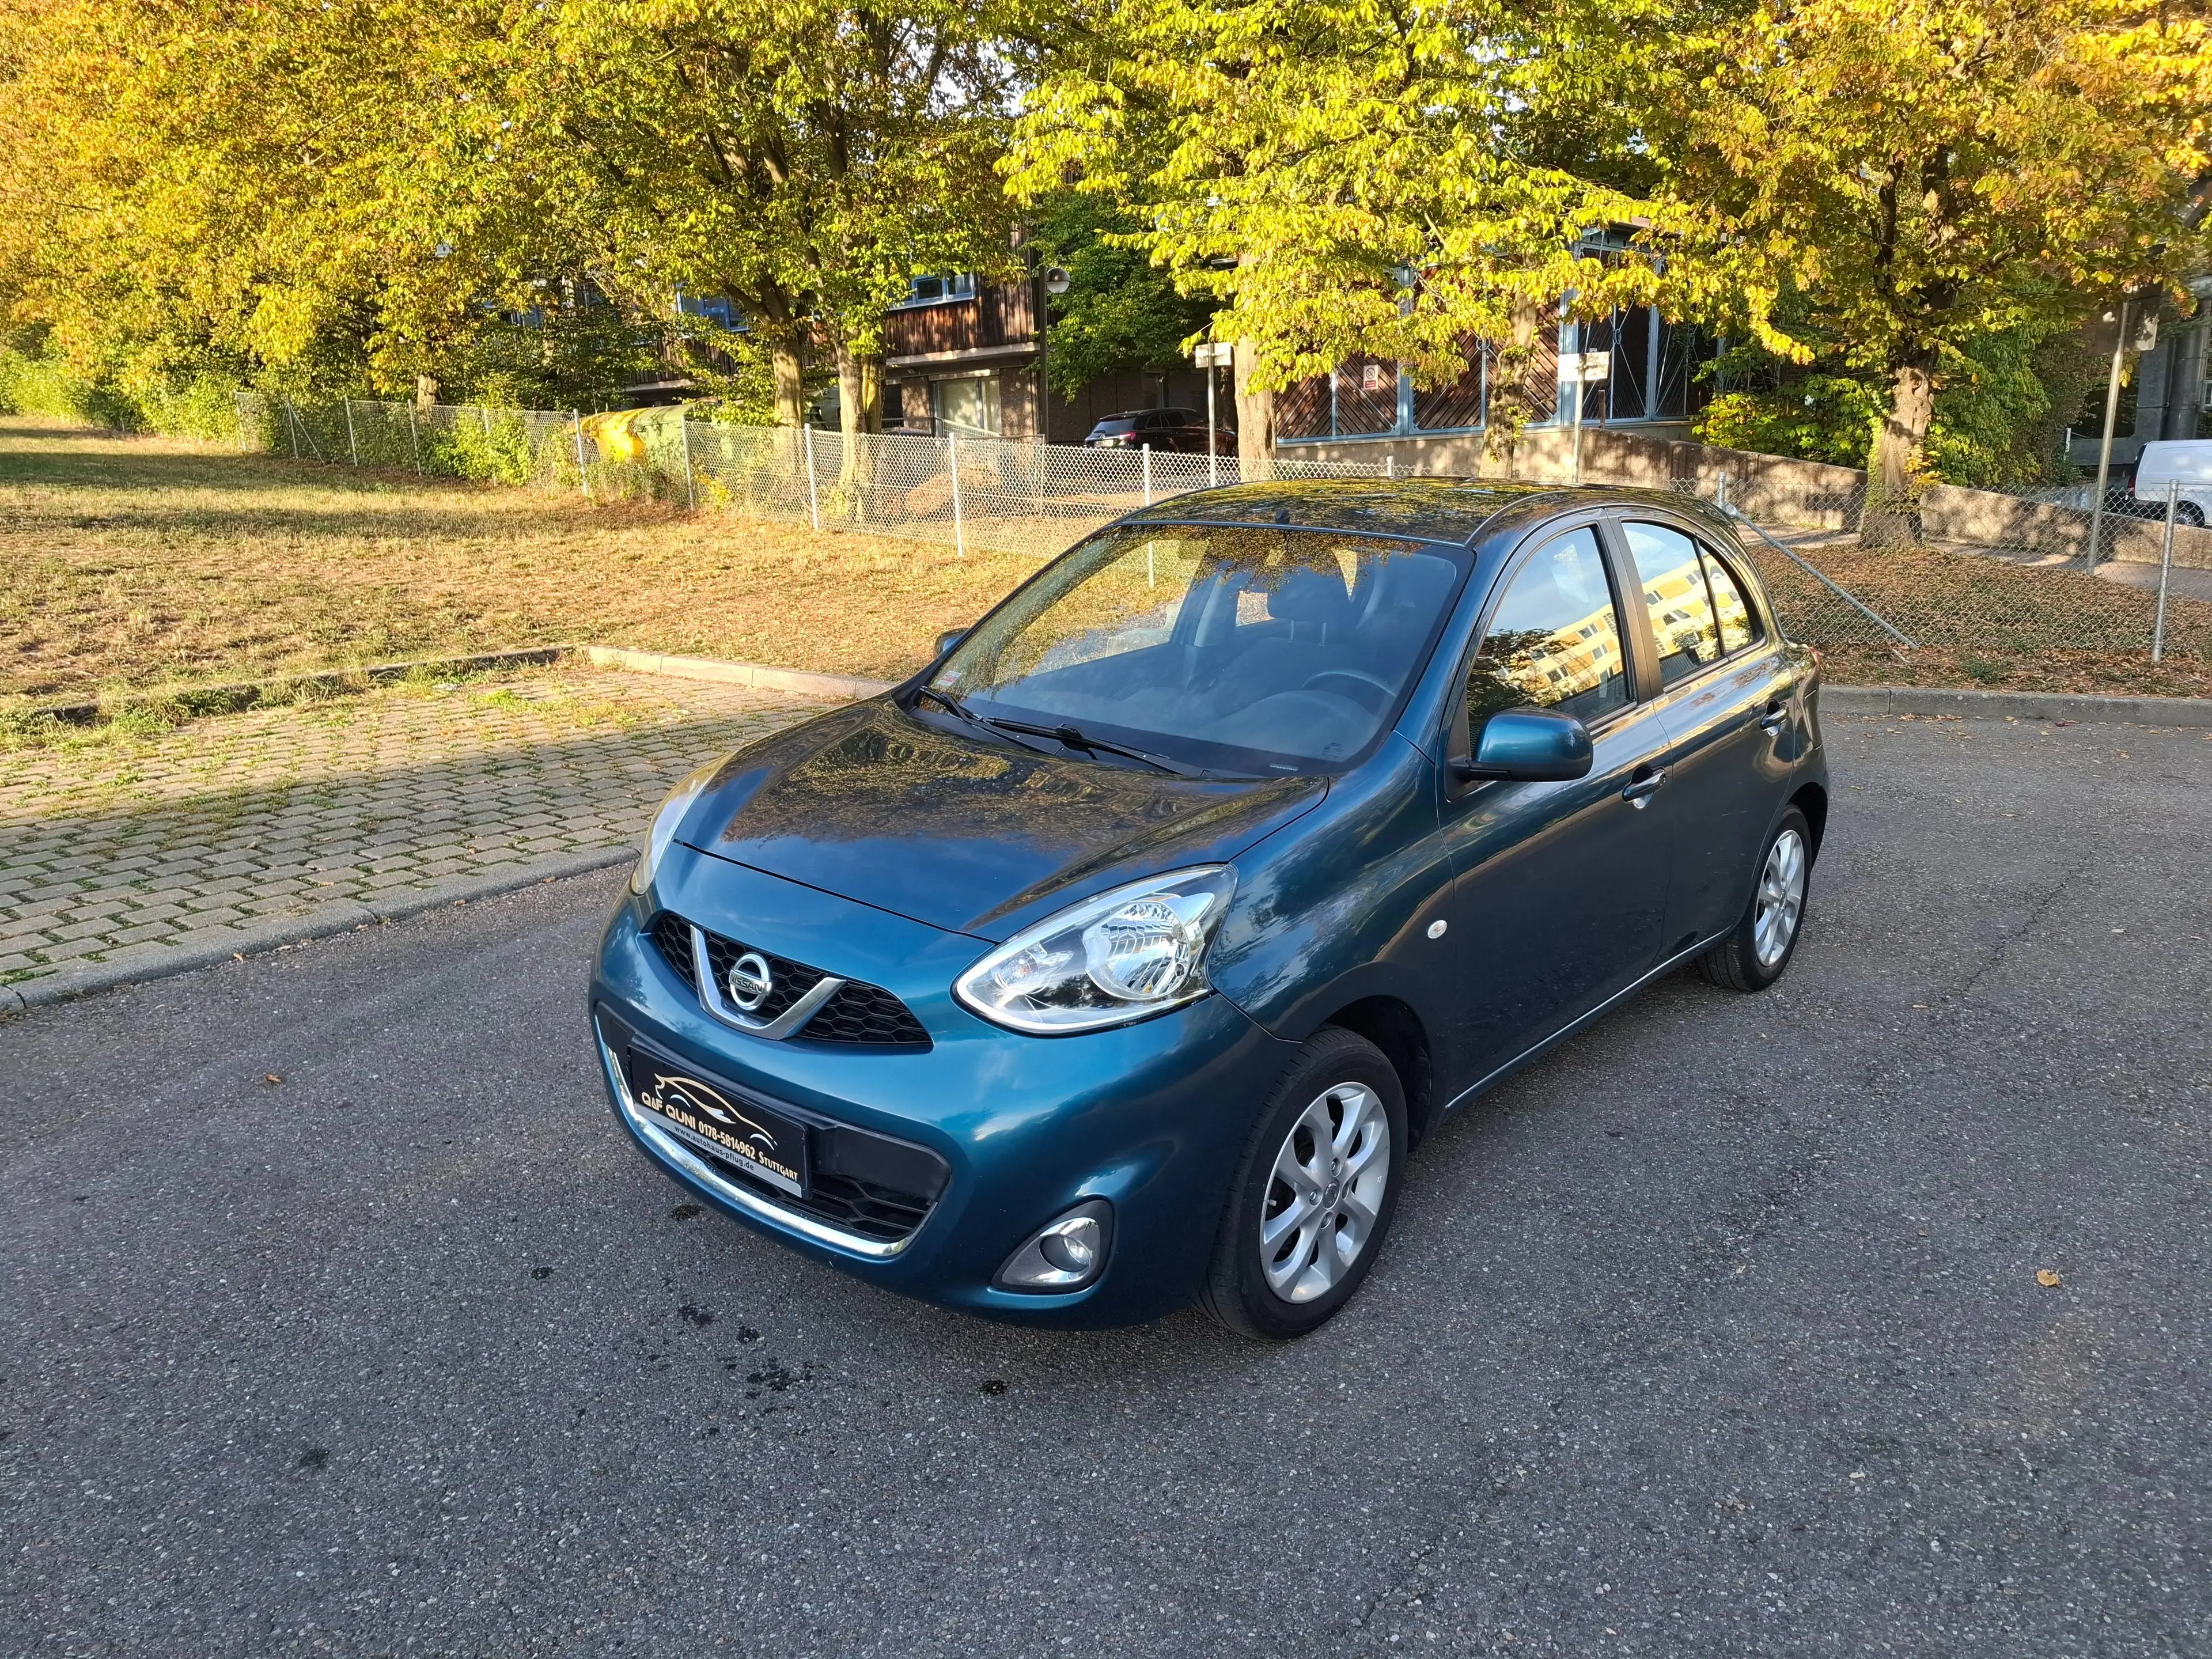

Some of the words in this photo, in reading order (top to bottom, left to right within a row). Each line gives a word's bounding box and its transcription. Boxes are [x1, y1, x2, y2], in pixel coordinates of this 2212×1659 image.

[731, 974, 762, 993] NISSAN
[666, 1104, 696, 1130] QUNI
[699, 1120, 756, 1160] 0178-5814962
[675, 1126, 754, 1171] www.autohaus-pflug.de
